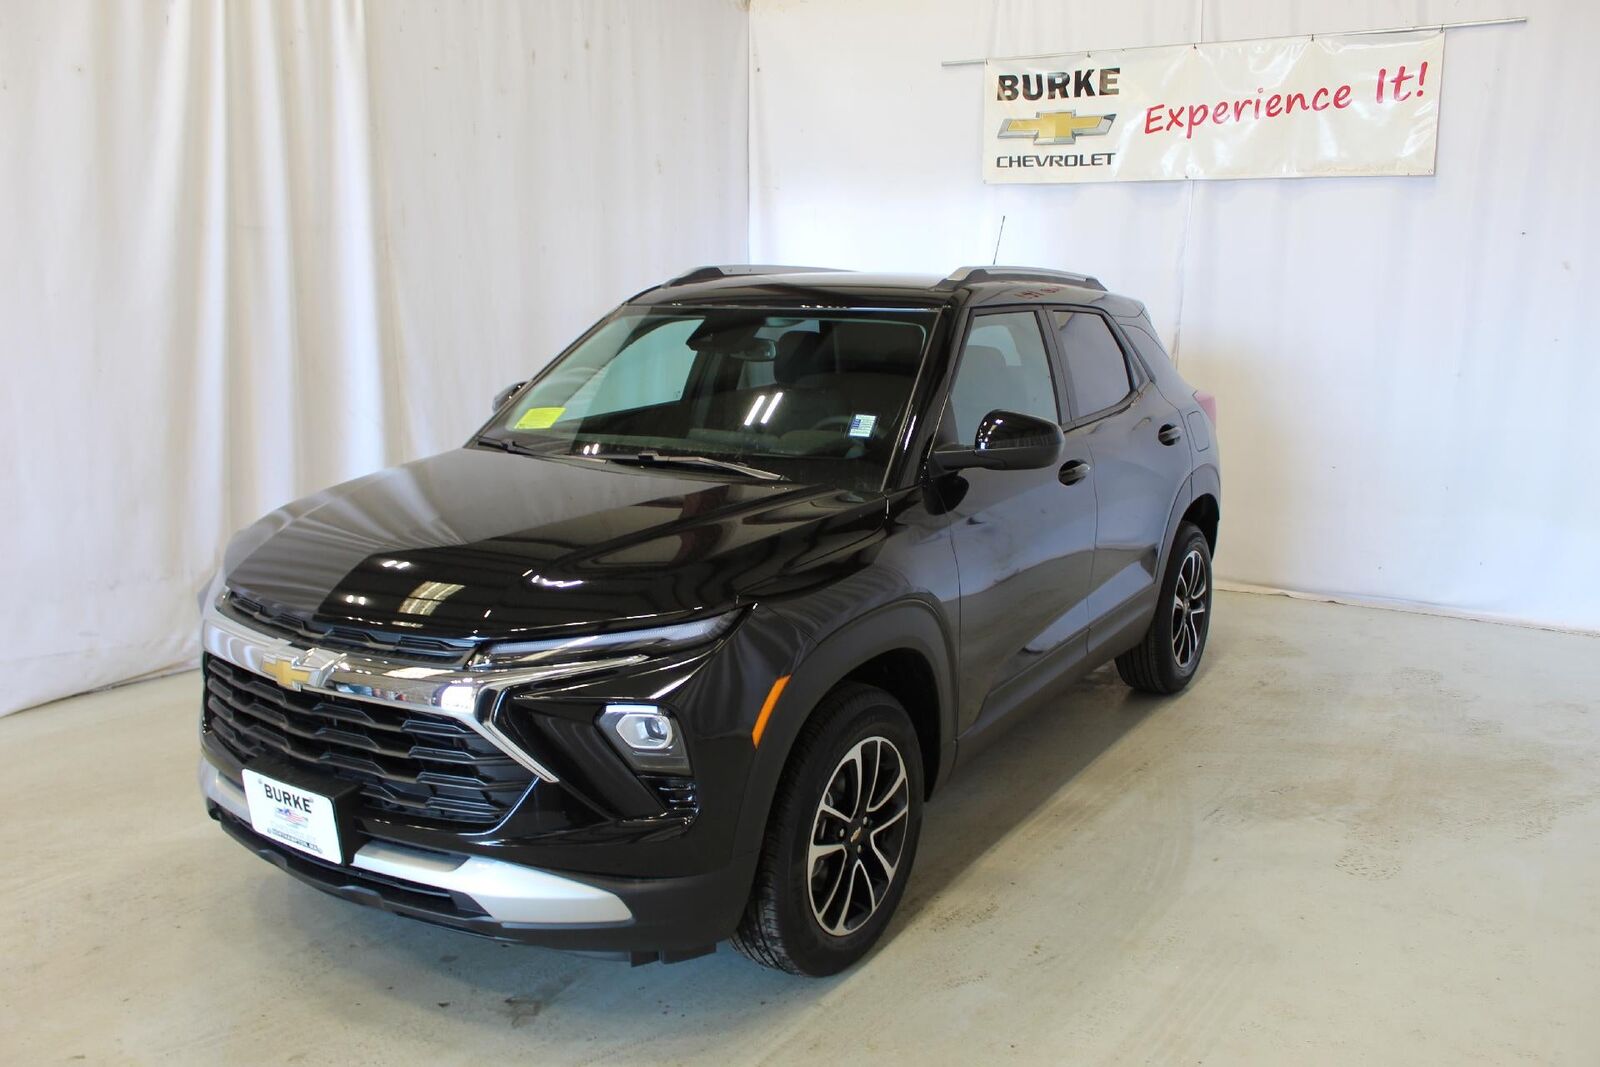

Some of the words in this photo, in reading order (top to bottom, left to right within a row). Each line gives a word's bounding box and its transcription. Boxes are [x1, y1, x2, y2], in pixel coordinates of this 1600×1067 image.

[997, 67, 1120, 101] BURKE
[1144, 84, 1352, 139] Experience
[1377, 61, 1429, 104] It!
[996, 152, 1116, 168] CHEVROLET
[264, 784, 312, 813] BURKE
